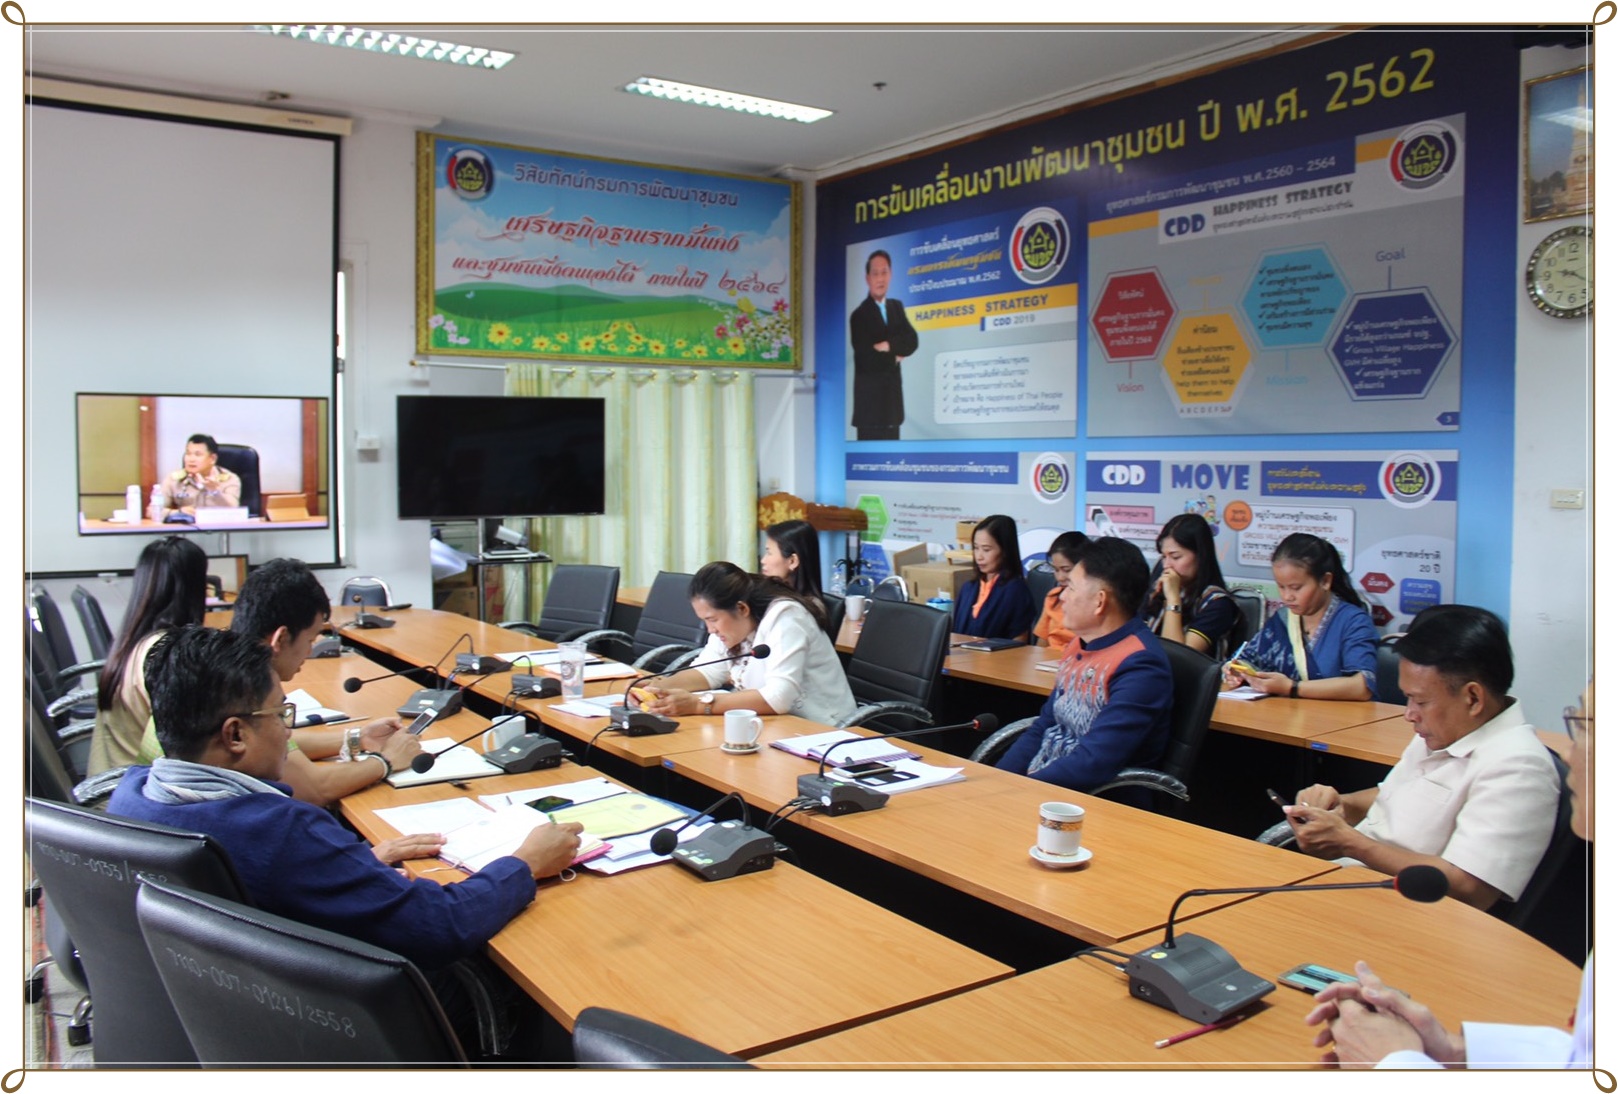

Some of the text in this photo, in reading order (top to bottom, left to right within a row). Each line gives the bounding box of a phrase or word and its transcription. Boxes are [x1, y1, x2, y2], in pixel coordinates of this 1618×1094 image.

[855, 48, 1435, 224] การขับเคลื่อนงานพัฒนาชุมชน ปี พ.ศ. 2562
[1307, 156, 1336, 171] 2564
[514, 164, 738, 209] วิสัยทัศน์กรมการพัฒนาชุมชน
[1213, 181, 1354, 217] HAPPINESS STRATEGY
[477, 208, 745, 254] เศรษฐกิจฐานรากมั่นคง
[1164, 213, 1206, 238] CDD
[1376, 248, 1406, 263] Goal
[452, 254, 786, 295] และชุมชนพึ่งตนเองได้ ภายในปี ๒๕๖๔
[915, 294, 1049, 321] HAPPINESS STRATEGY
[993, 314, 1035, 327] CDD 2019
[1117, 383, 1144, 393] Vision
[1102, 464, 1249, 490] CDD MOVE
[1419, 564, 1431, 573] 20
